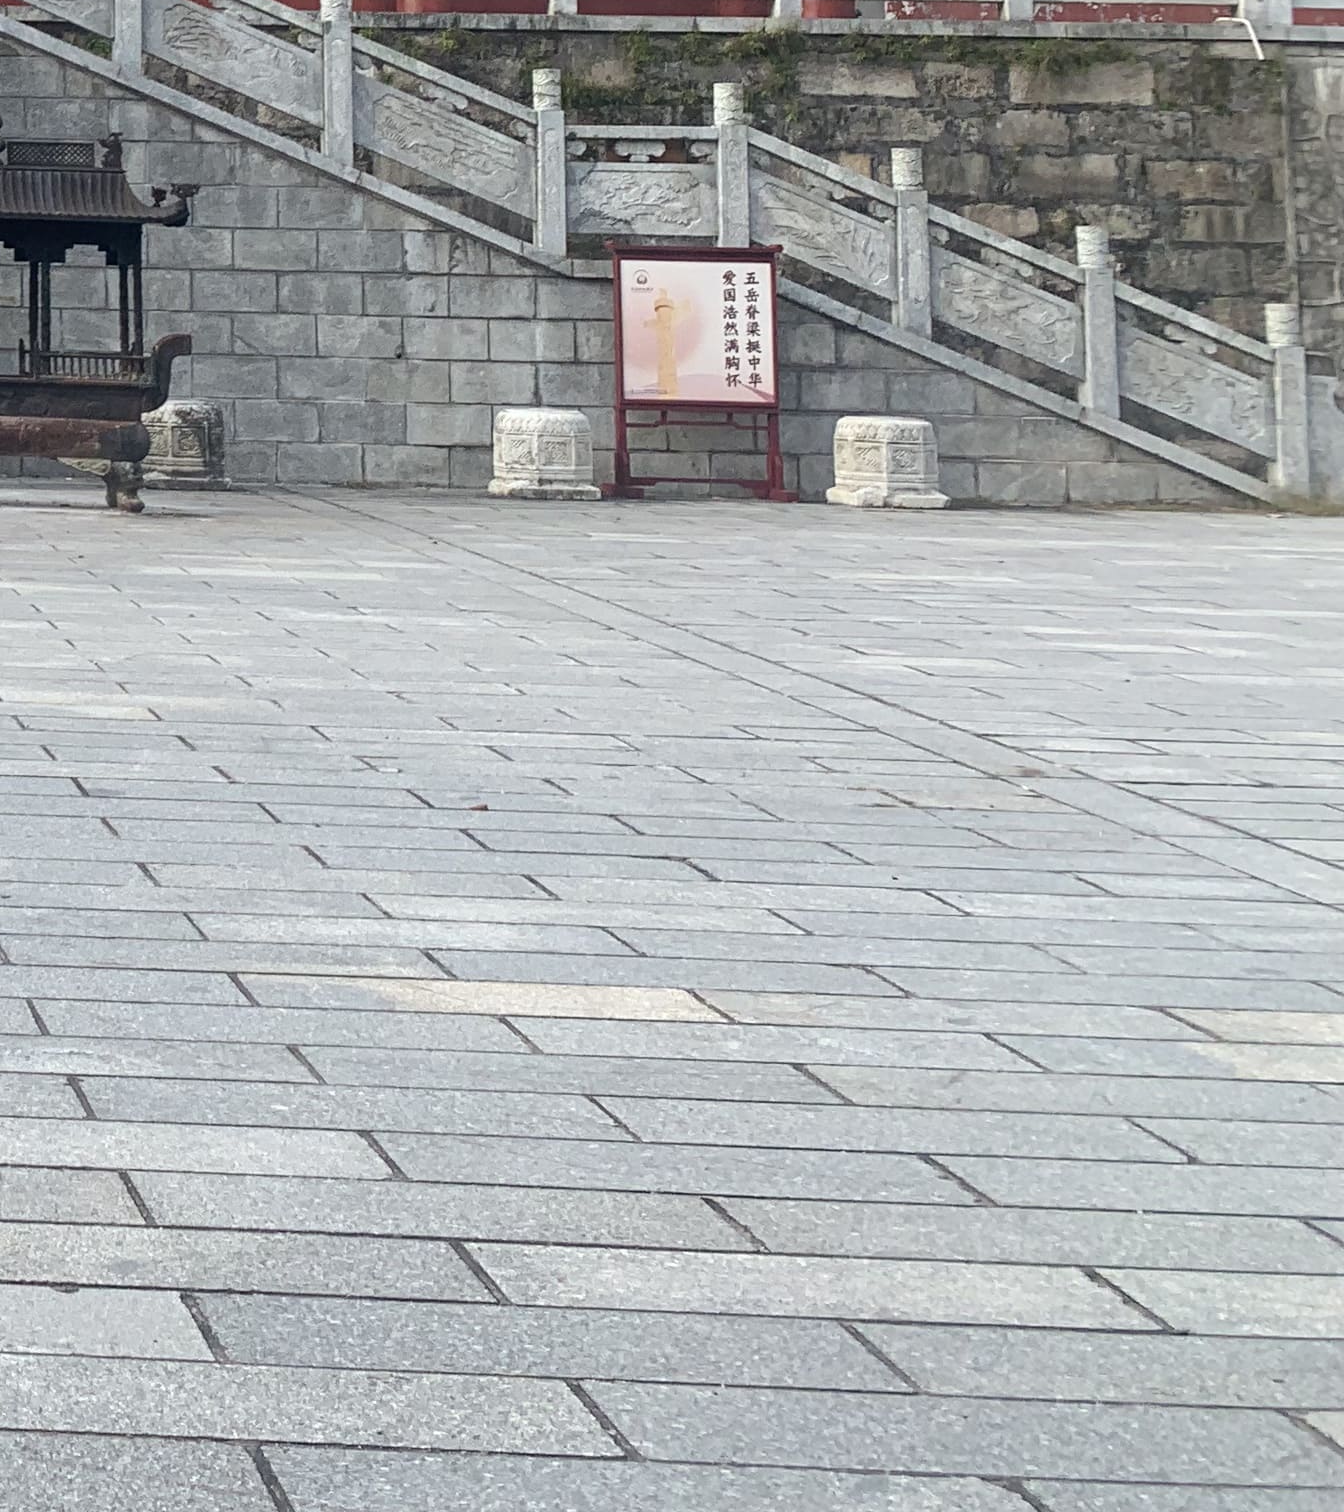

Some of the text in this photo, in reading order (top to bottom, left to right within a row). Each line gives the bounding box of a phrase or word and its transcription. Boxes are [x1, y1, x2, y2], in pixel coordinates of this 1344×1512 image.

[722, 270, 742, 388] 爱国浩然满胸怀
[743, 273, 762, 388] 五岳脊梁挺中华
